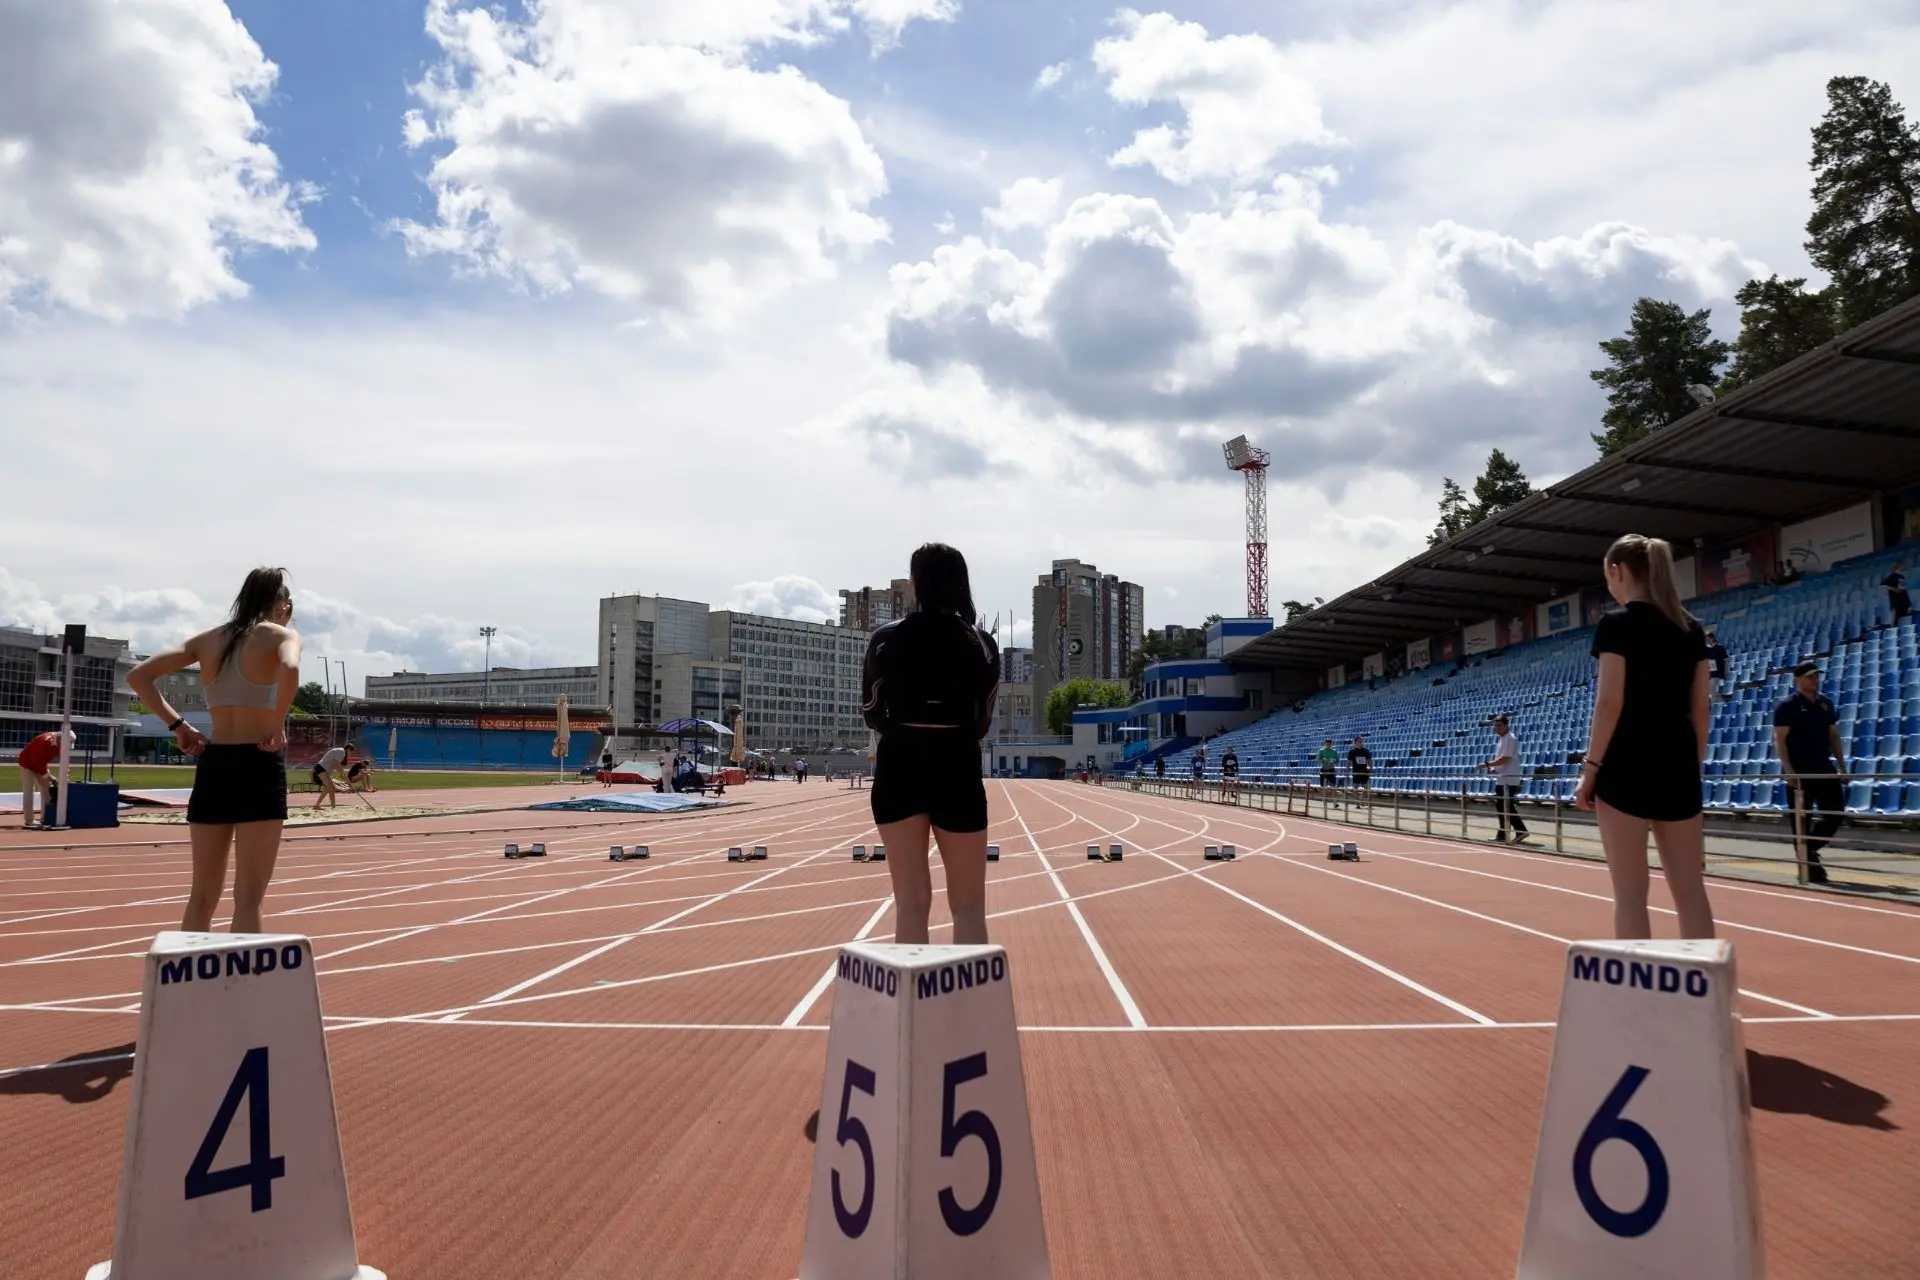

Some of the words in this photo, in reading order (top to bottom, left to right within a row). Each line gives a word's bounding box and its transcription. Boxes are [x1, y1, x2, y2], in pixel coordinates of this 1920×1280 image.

[161, 945, 303, 985] MONDO
[838, 954, 898, 998] MONDO
[917, 956, 1004, 1000] MONDO
[1573, 954, 1709, 998] MONDO
[184, 1046, 285, 1213] 4
[831, 1058, 876, 1239] 5
[937, 1051, 1003, 1237] 5
[1572, 1064, 1669, 1238] 6
